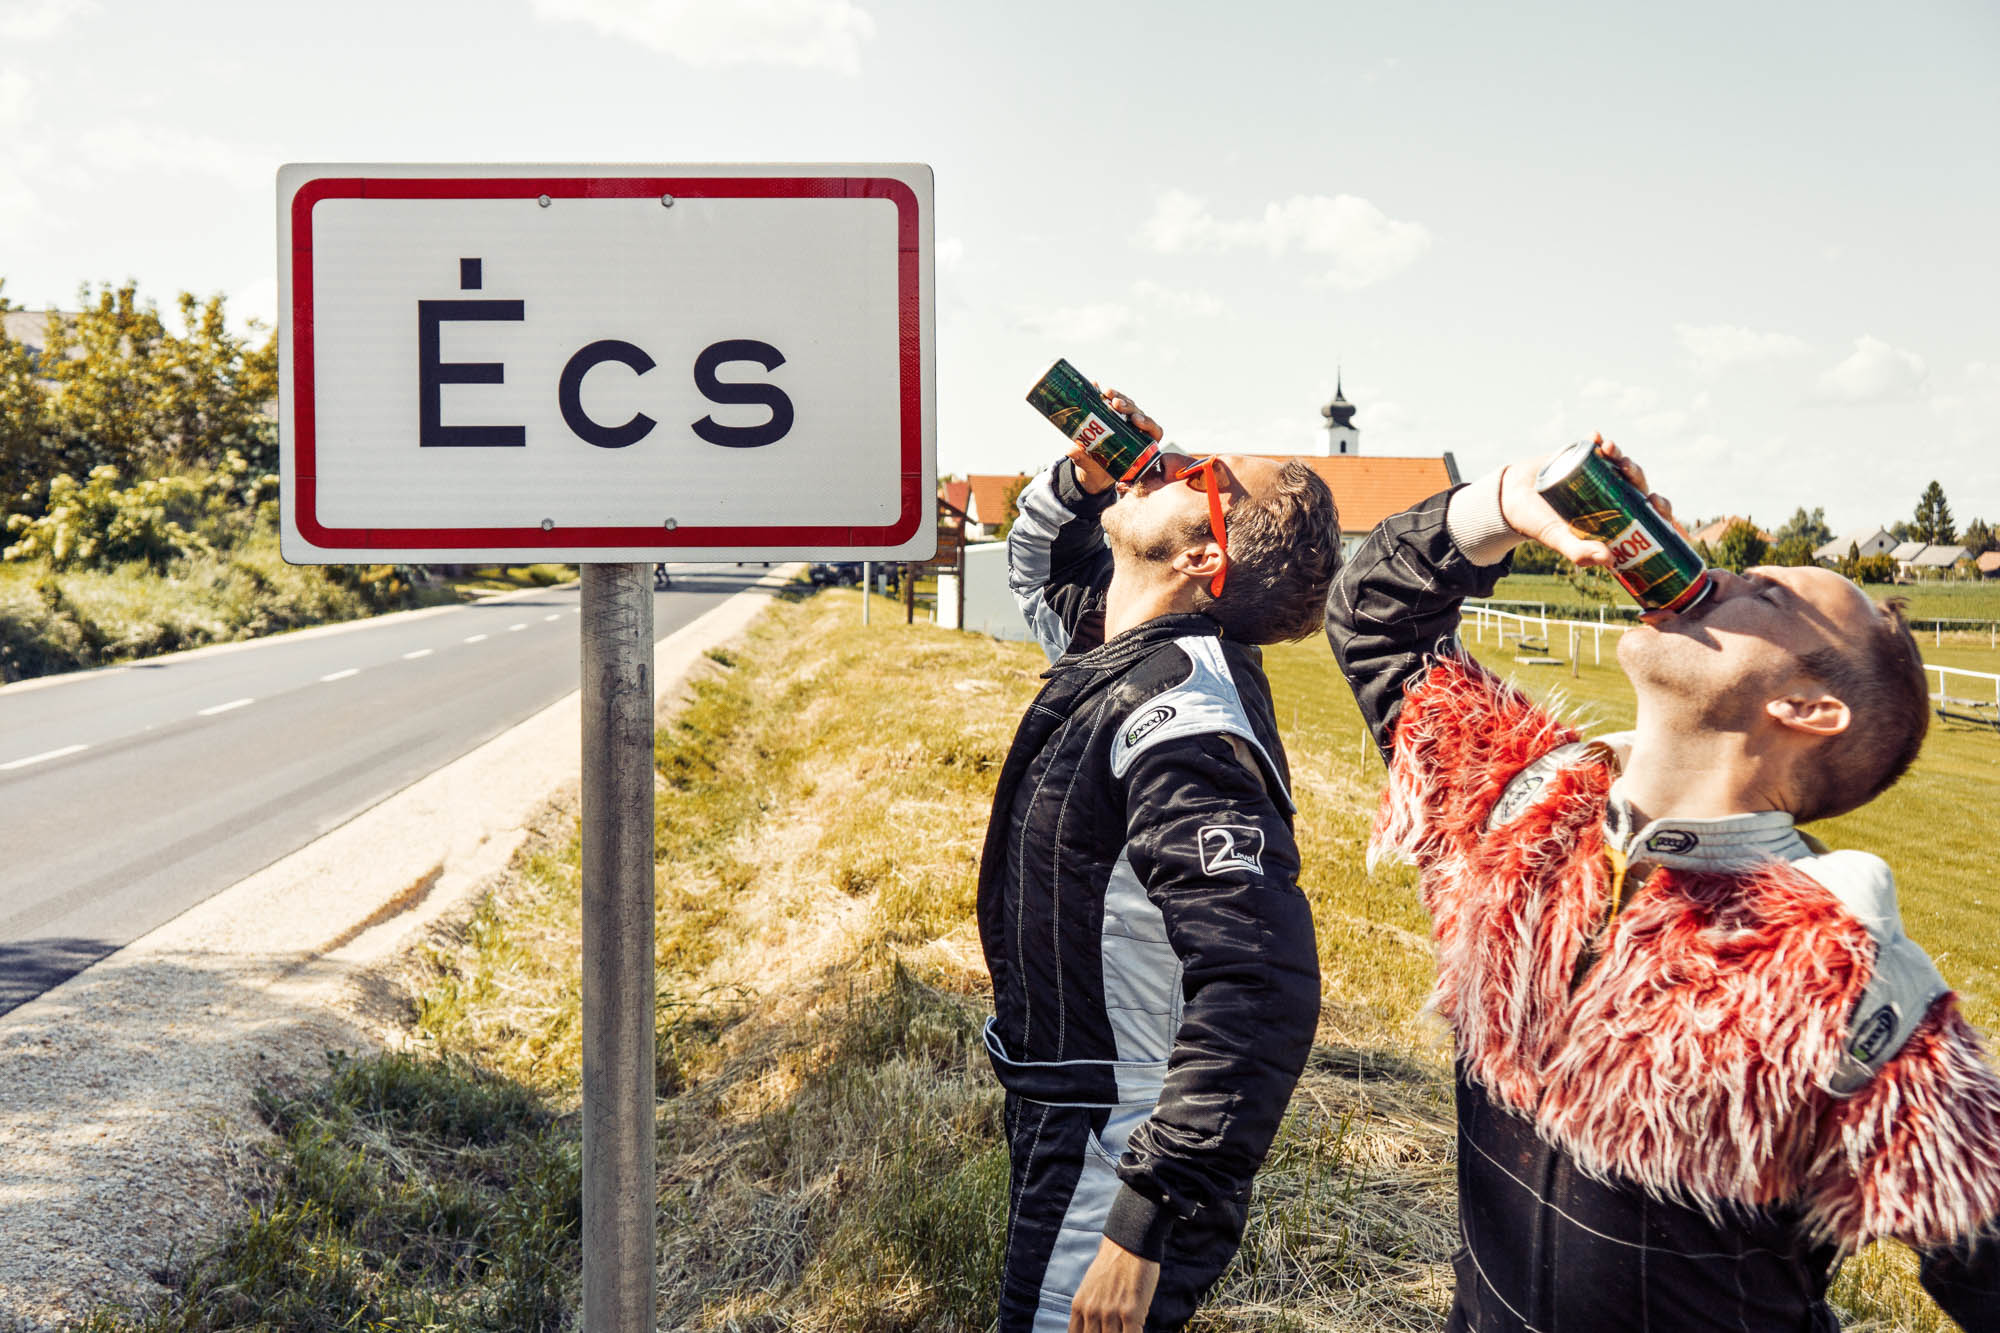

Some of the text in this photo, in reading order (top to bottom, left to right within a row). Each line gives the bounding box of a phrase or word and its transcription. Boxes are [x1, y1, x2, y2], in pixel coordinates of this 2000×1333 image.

[1075, 419, 1105, 451] BOR
[1611, 529, 1653, 567] BOR
[1127, 711, 1162, 744] speed
[1203, 828, 1260, 872] 2 Level
